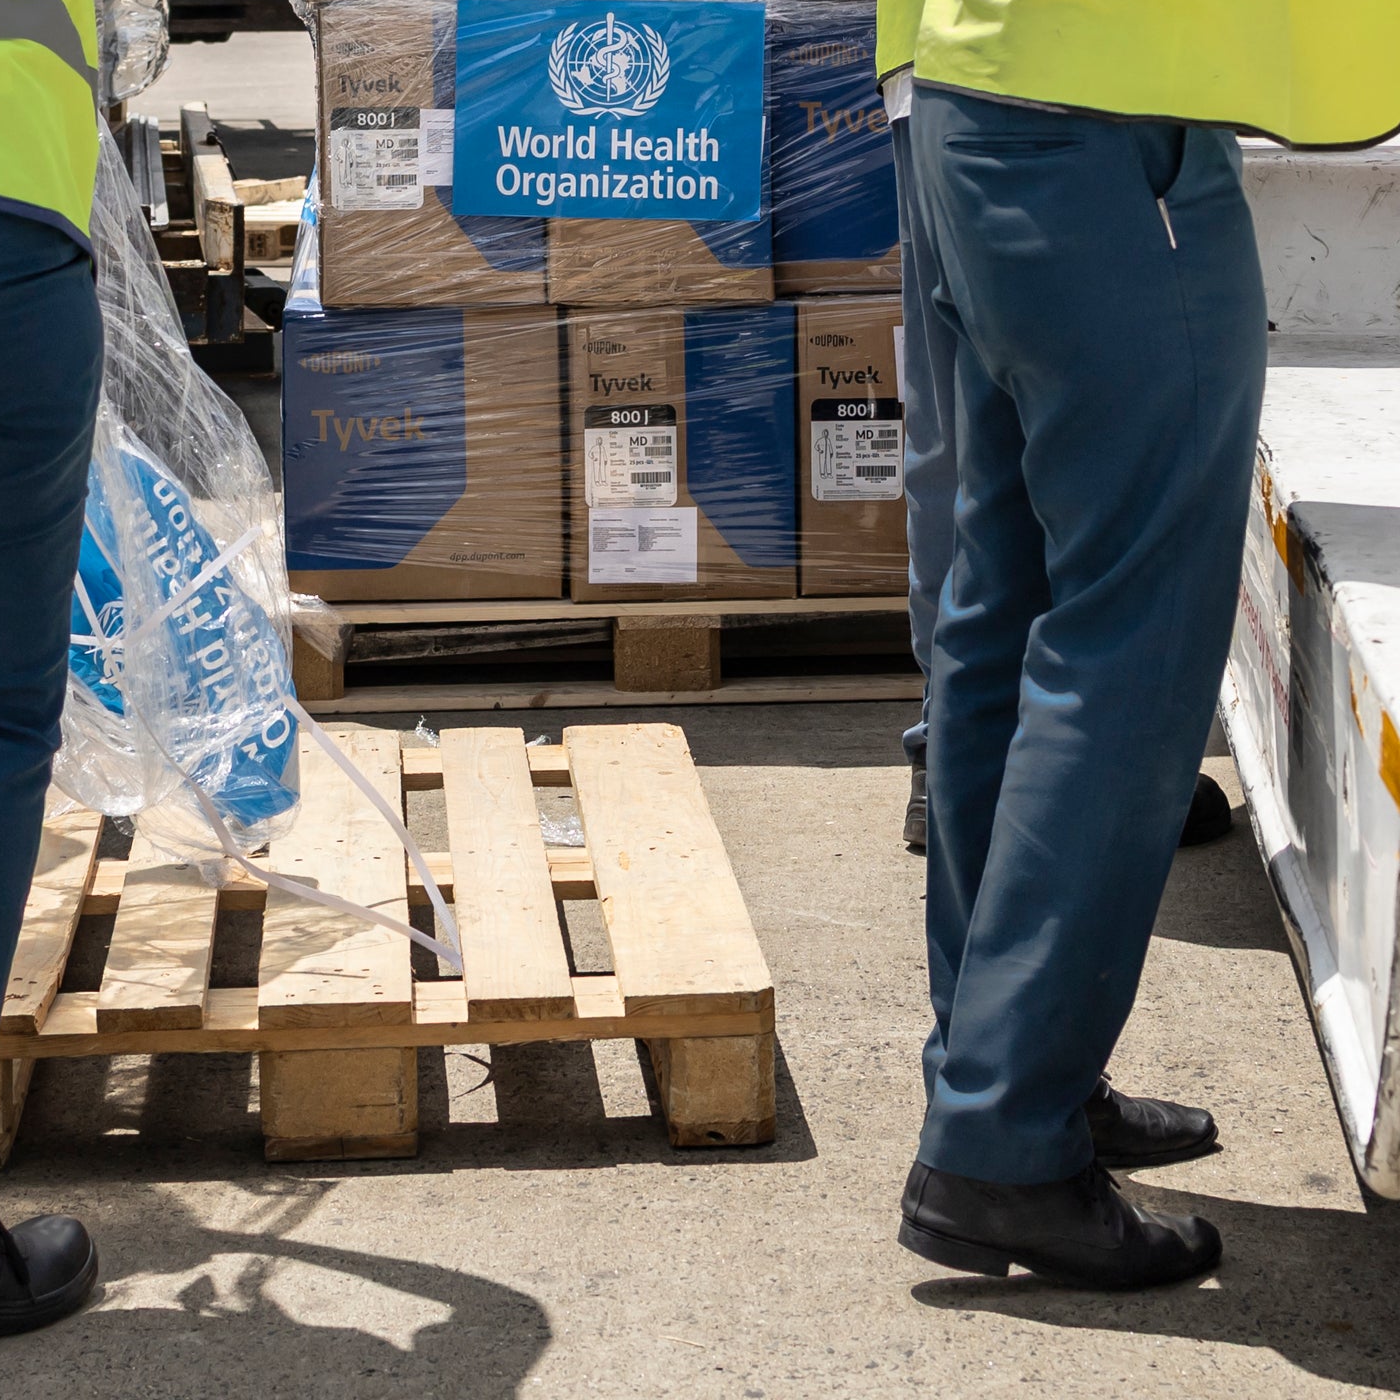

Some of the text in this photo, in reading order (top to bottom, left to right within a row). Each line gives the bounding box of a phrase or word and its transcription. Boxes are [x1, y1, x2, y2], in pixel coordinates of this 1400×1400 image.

[338, 73, 403, 98] Tyvek
[357, 112, 395, 128] 800 J
[798, 101, 888, 144] Tyve
[376, 139, 394, 149] MD
[497, 125, 719, 162] World Health
[495, 163, 719, 206] Organization
[587, 341, 621, 355] DUPONT
[815, 334, 849, 348] DUPONT
[310, 351, 371, 374] DUPONT
[589, 373, 652, 397] Tyvek
[816, 366, 879, 389] Tyvek
[611, 409, 649, 426] 800 J
[837, 403, 875, 419] 800 J
[311, 407, 425, 452] Tyvek
[855, 429, 874, 440] MD
[629, 436, 648, 446] MD
[450, 552, 525, 563] dpp.dupont.com
